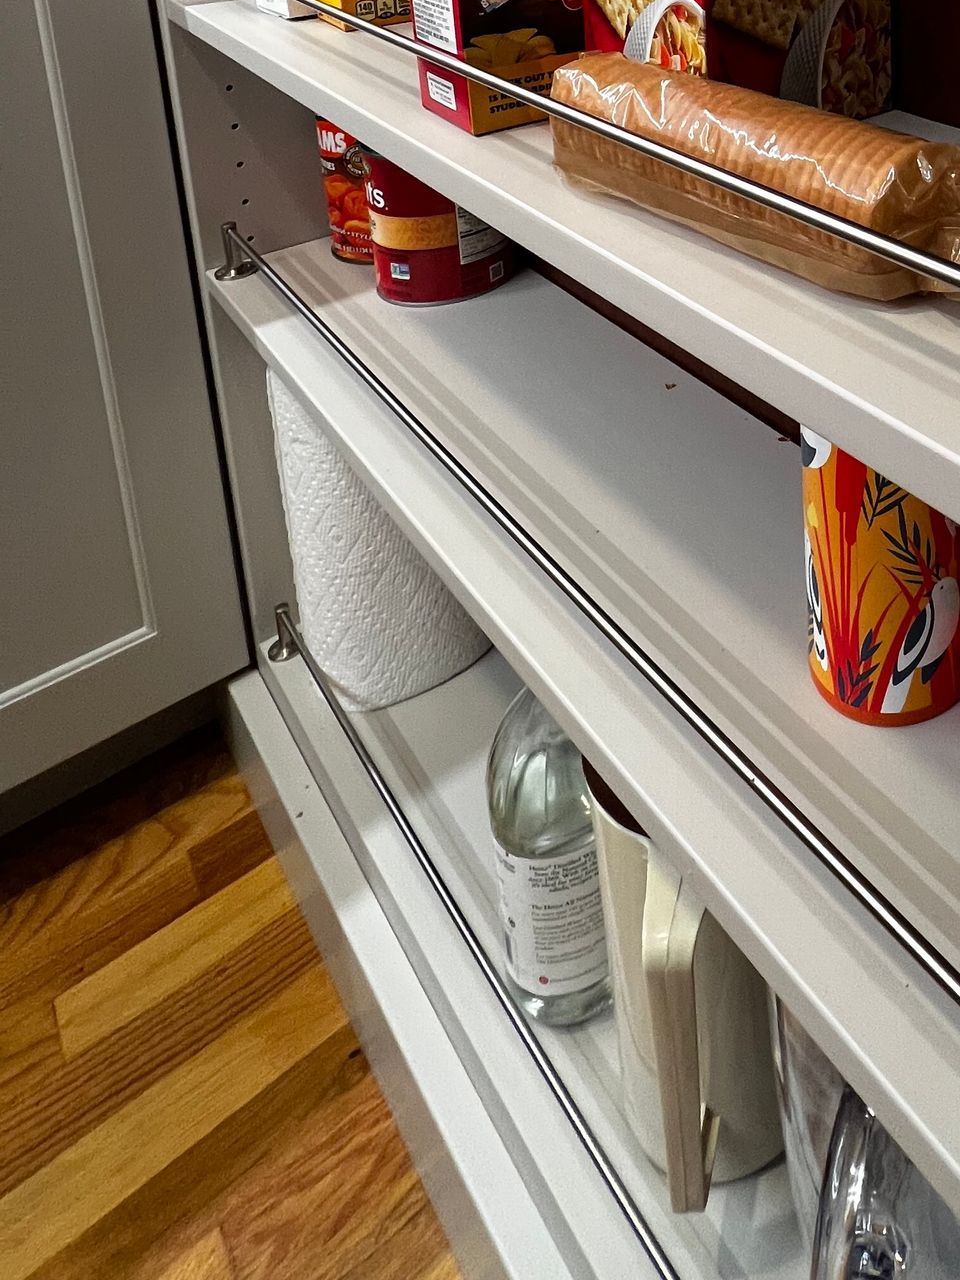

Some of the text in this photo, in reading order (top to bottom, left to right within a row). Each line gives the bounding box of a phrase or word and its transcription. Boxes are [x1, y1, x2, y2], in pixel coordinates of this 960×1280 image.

[358, 3, 373, 12] 140
[524, 72, 545, 84] OUT
[489, 100, 527, 114] STUDE
